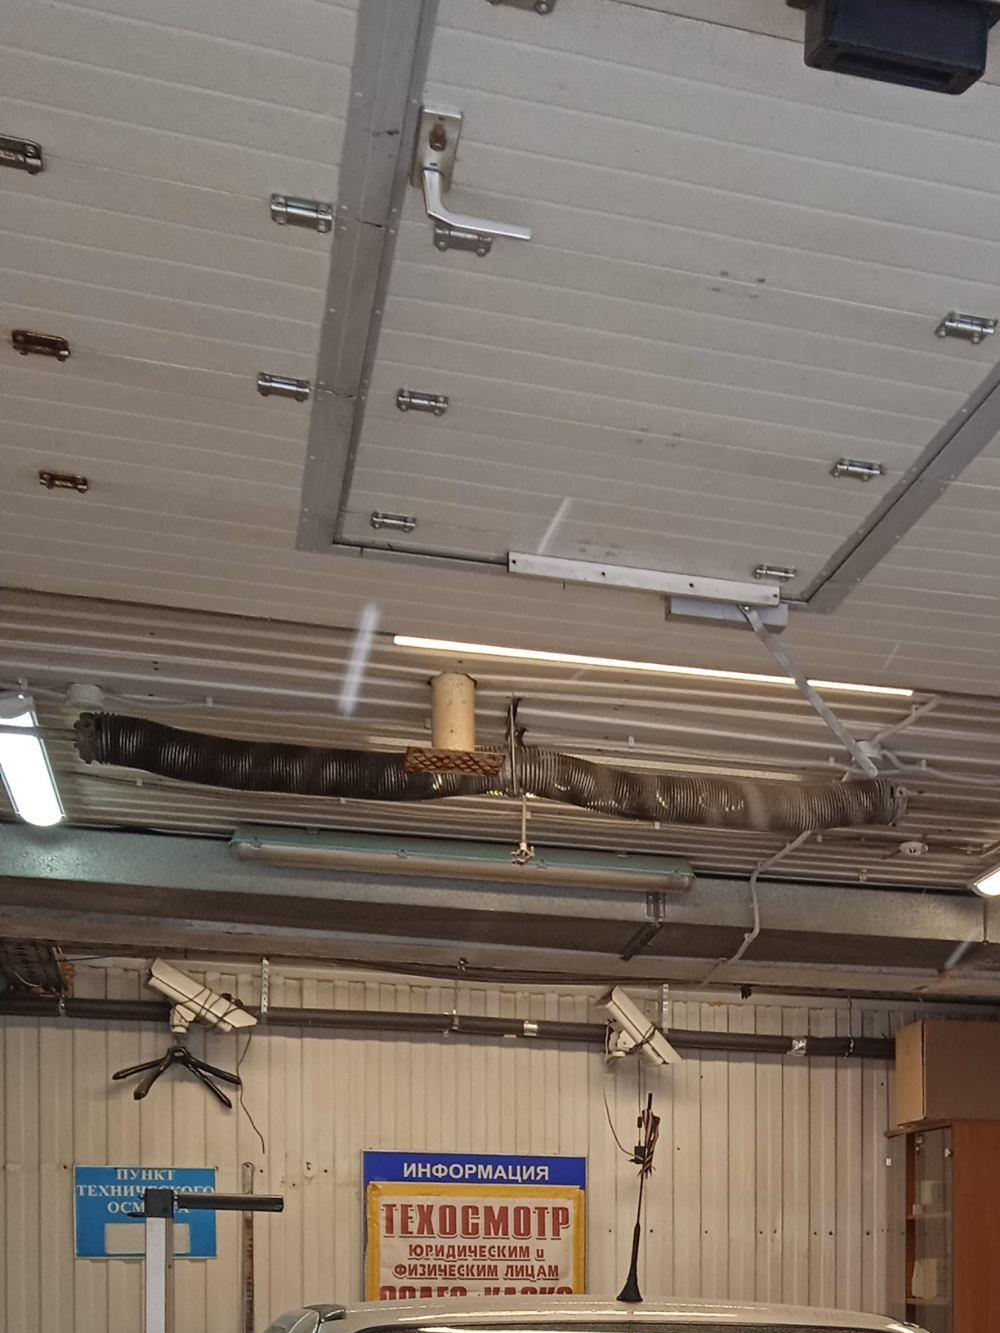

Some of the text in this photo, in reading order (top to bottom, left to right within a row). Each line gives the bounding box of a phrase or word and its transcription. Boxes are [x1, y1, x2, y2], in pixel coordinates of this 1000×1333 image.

[116, 1168, 176, 1181] ПУНКТ
[403, 1163, 549, 1182] ИНФОРМАЦИЯ
[382, 1203, 571, 1240] ТЕХОСМОТР
[408, 1244, 530, 1262] ЮРИДИЧЕСКИМ
[392, 1263, 559, 1282] ФИЗИЧЕСКИМ ЛИЦАМ
